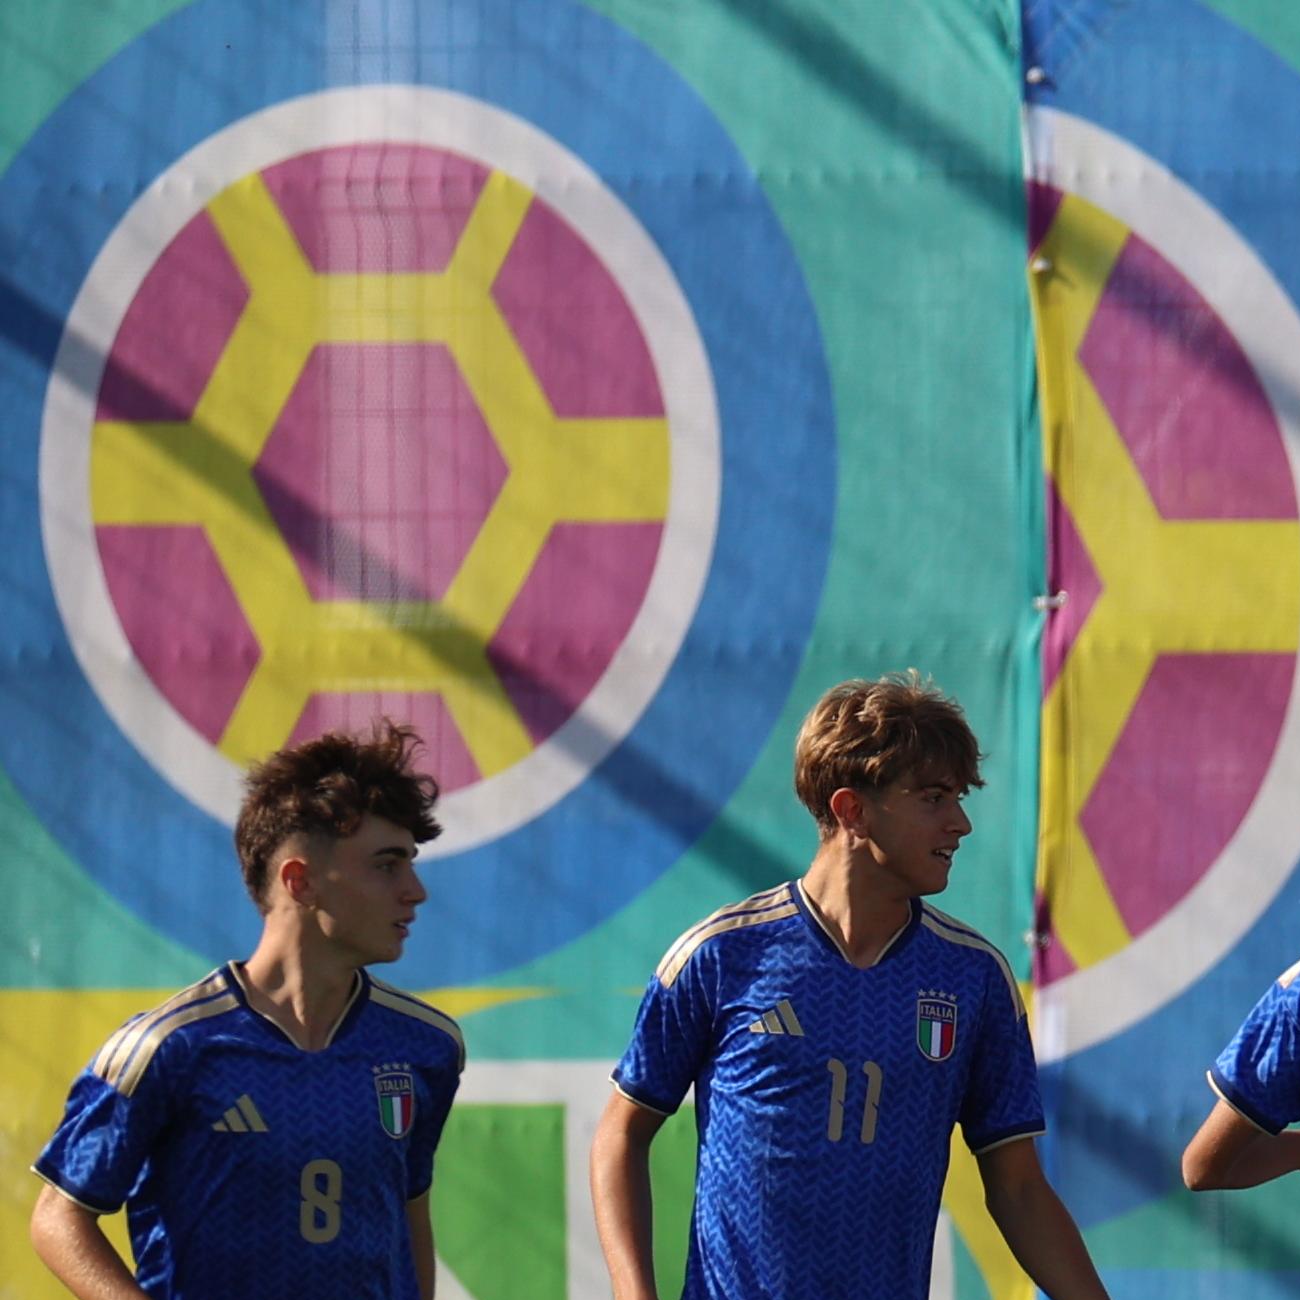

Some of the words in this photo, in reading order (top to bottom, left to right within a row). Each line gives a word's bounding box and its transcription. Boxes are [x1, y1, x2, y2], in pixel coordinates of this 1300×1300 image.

[921, 1005, 954, 1019] ITALIA
[379, 1079, 410, 1092] ITALIA
[827, 1058, 883, 1144] 11
[301, 1159, 342, 1244] 8
